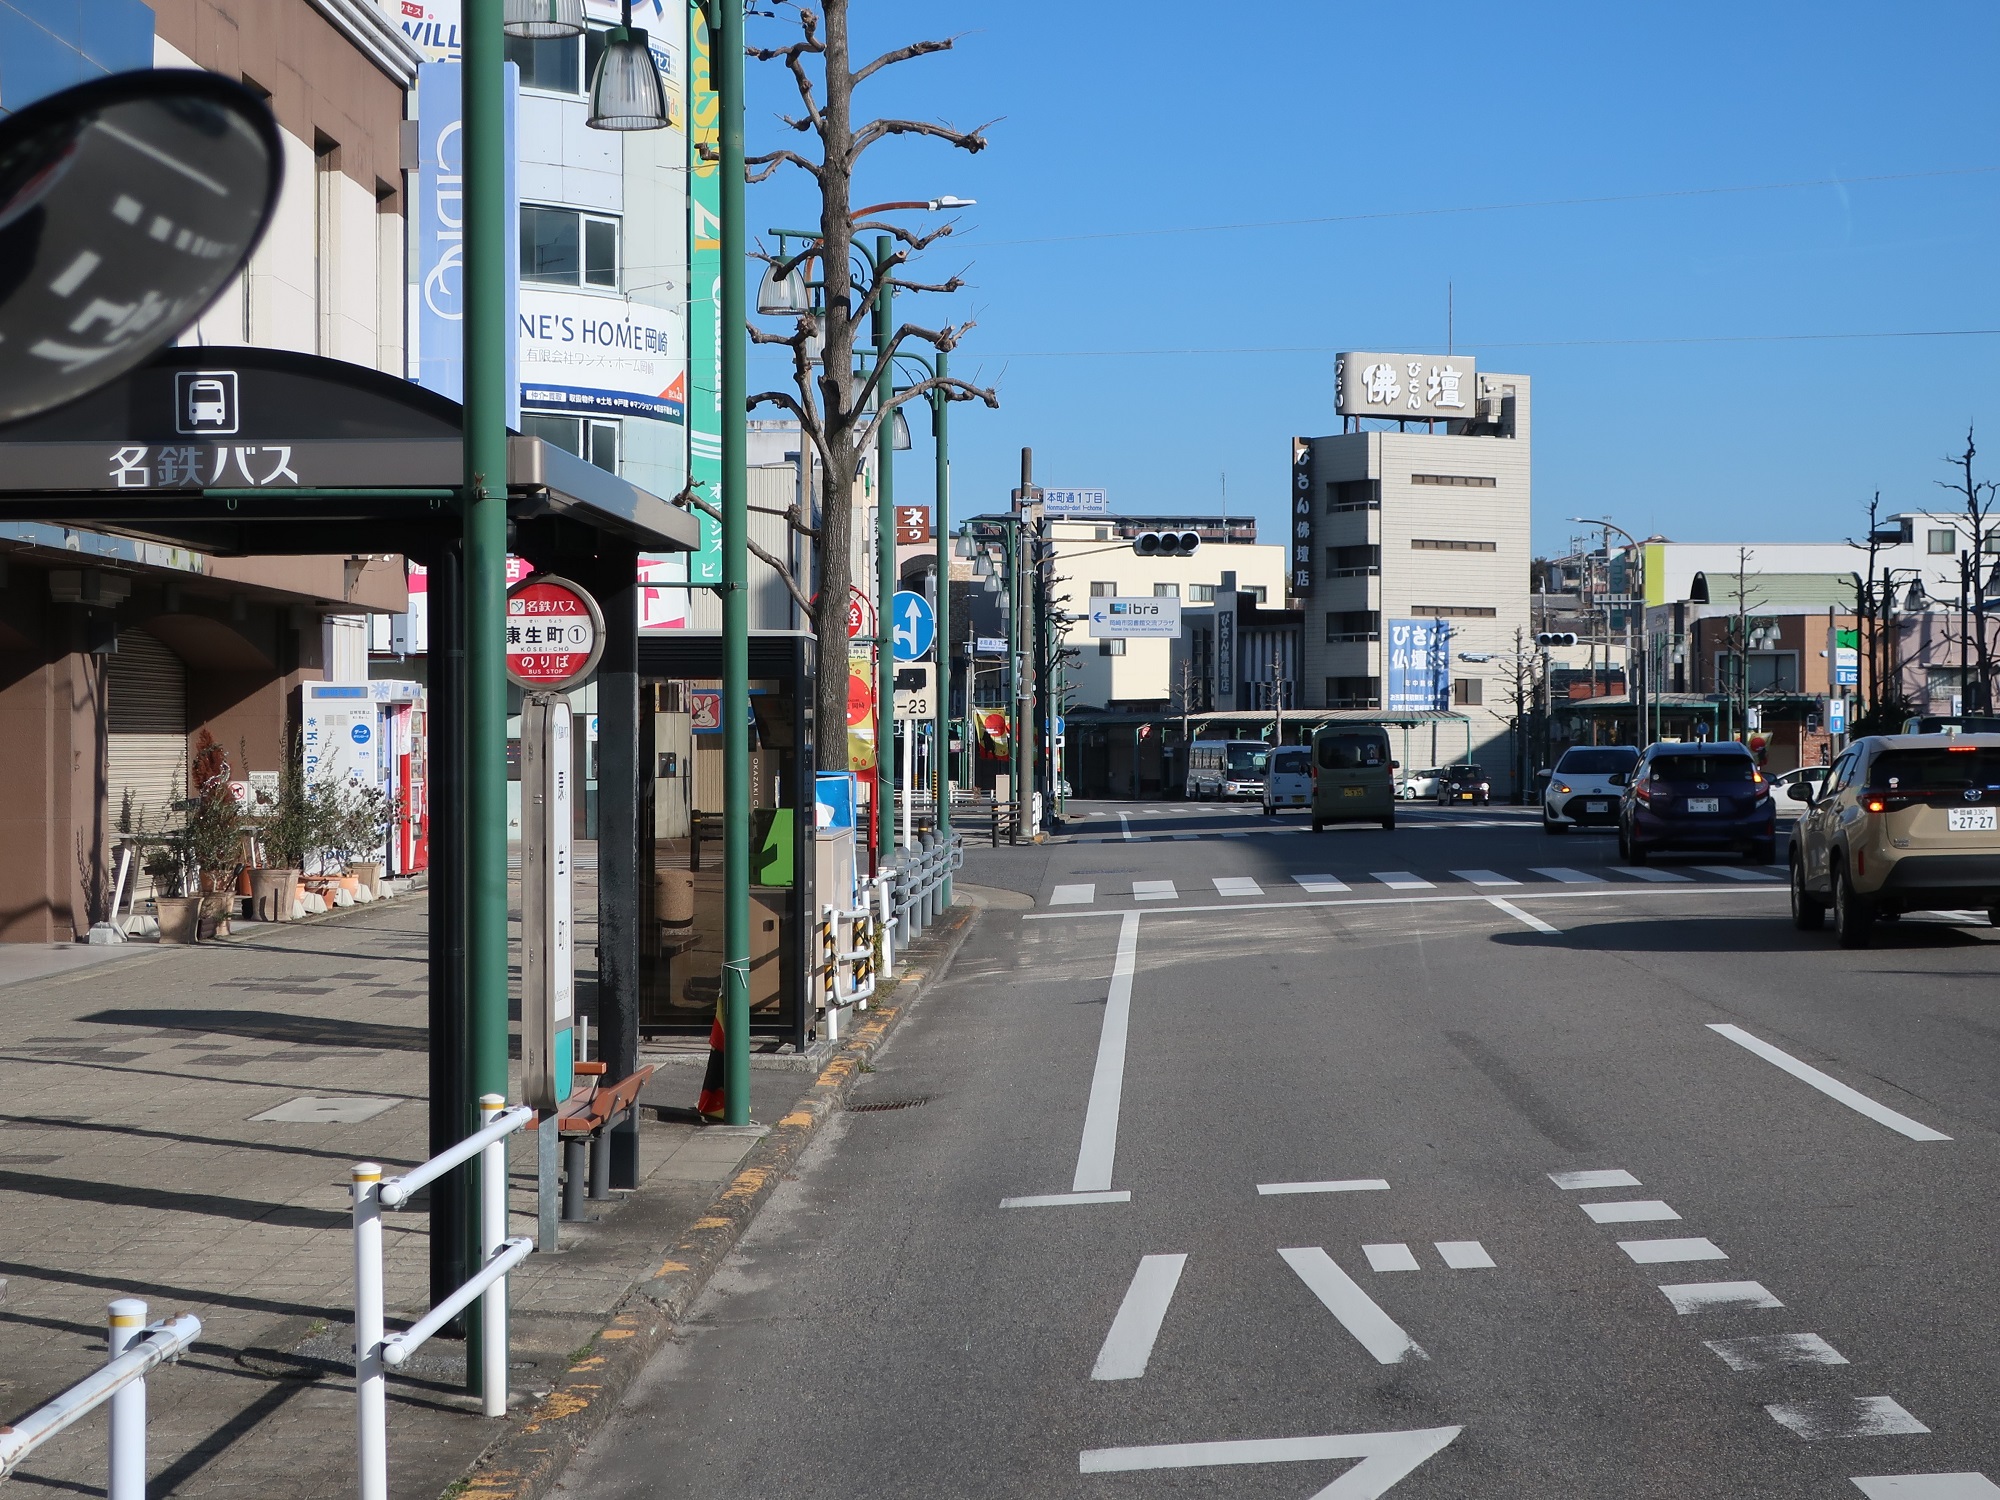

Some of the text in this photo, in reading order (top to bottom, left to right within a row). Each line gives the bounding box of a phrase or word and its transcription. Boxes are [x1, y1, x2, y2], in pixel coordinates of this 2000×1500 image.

[109, 446, 299, 487] 名鉄バス
[1046, 491, 1103, 504] 本町通1丁目
[1295, 447, 1311, 588] びさん佛壇店
[526, 601, 576, 613] 名鉄バス
[521, 655, 569, 668] のりば
[1834, 702, 1841, 714] P
[1959, 816, 1993, 829] 27-27
